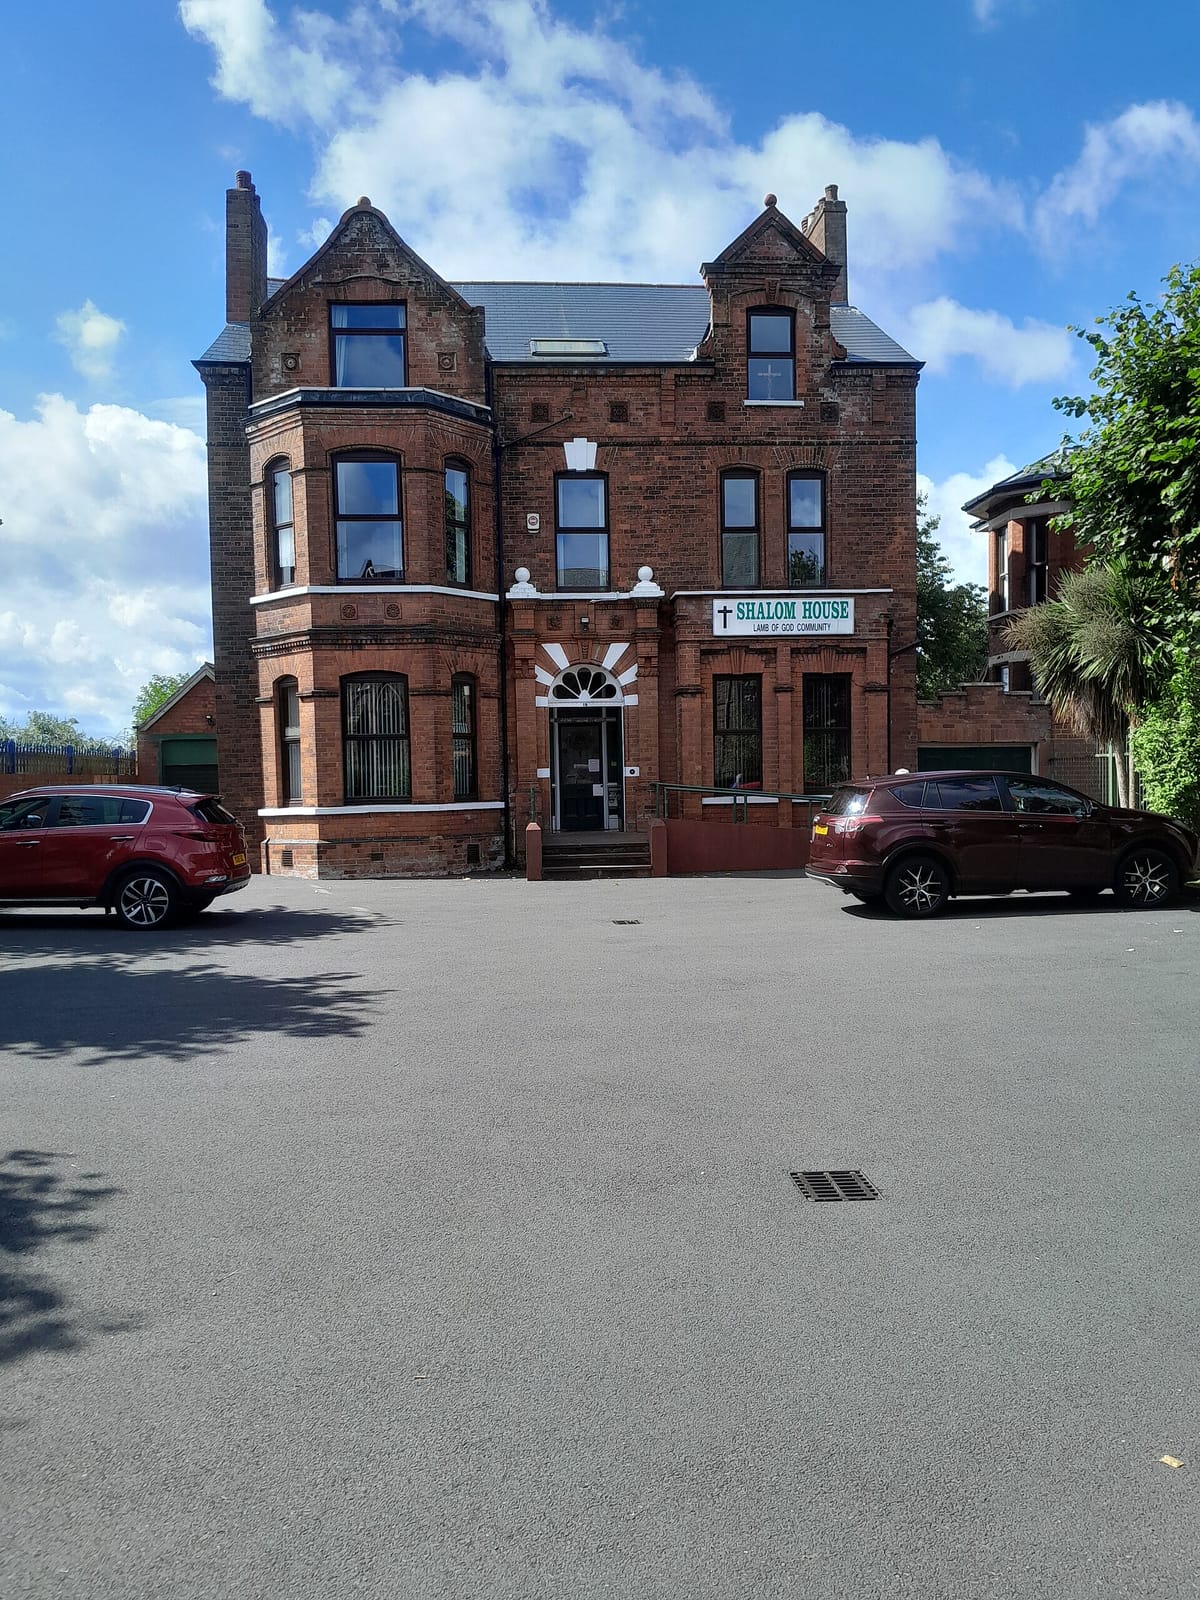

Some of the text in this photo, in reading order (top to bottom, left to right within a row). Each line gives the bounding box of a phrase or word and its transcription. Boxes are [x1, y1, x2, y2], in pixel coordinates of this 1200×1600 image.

[736, 601, 849, 620] SHALOM HOUSE
[753, 622, 831, 632] LAMB OF GOD COMMUNITY
